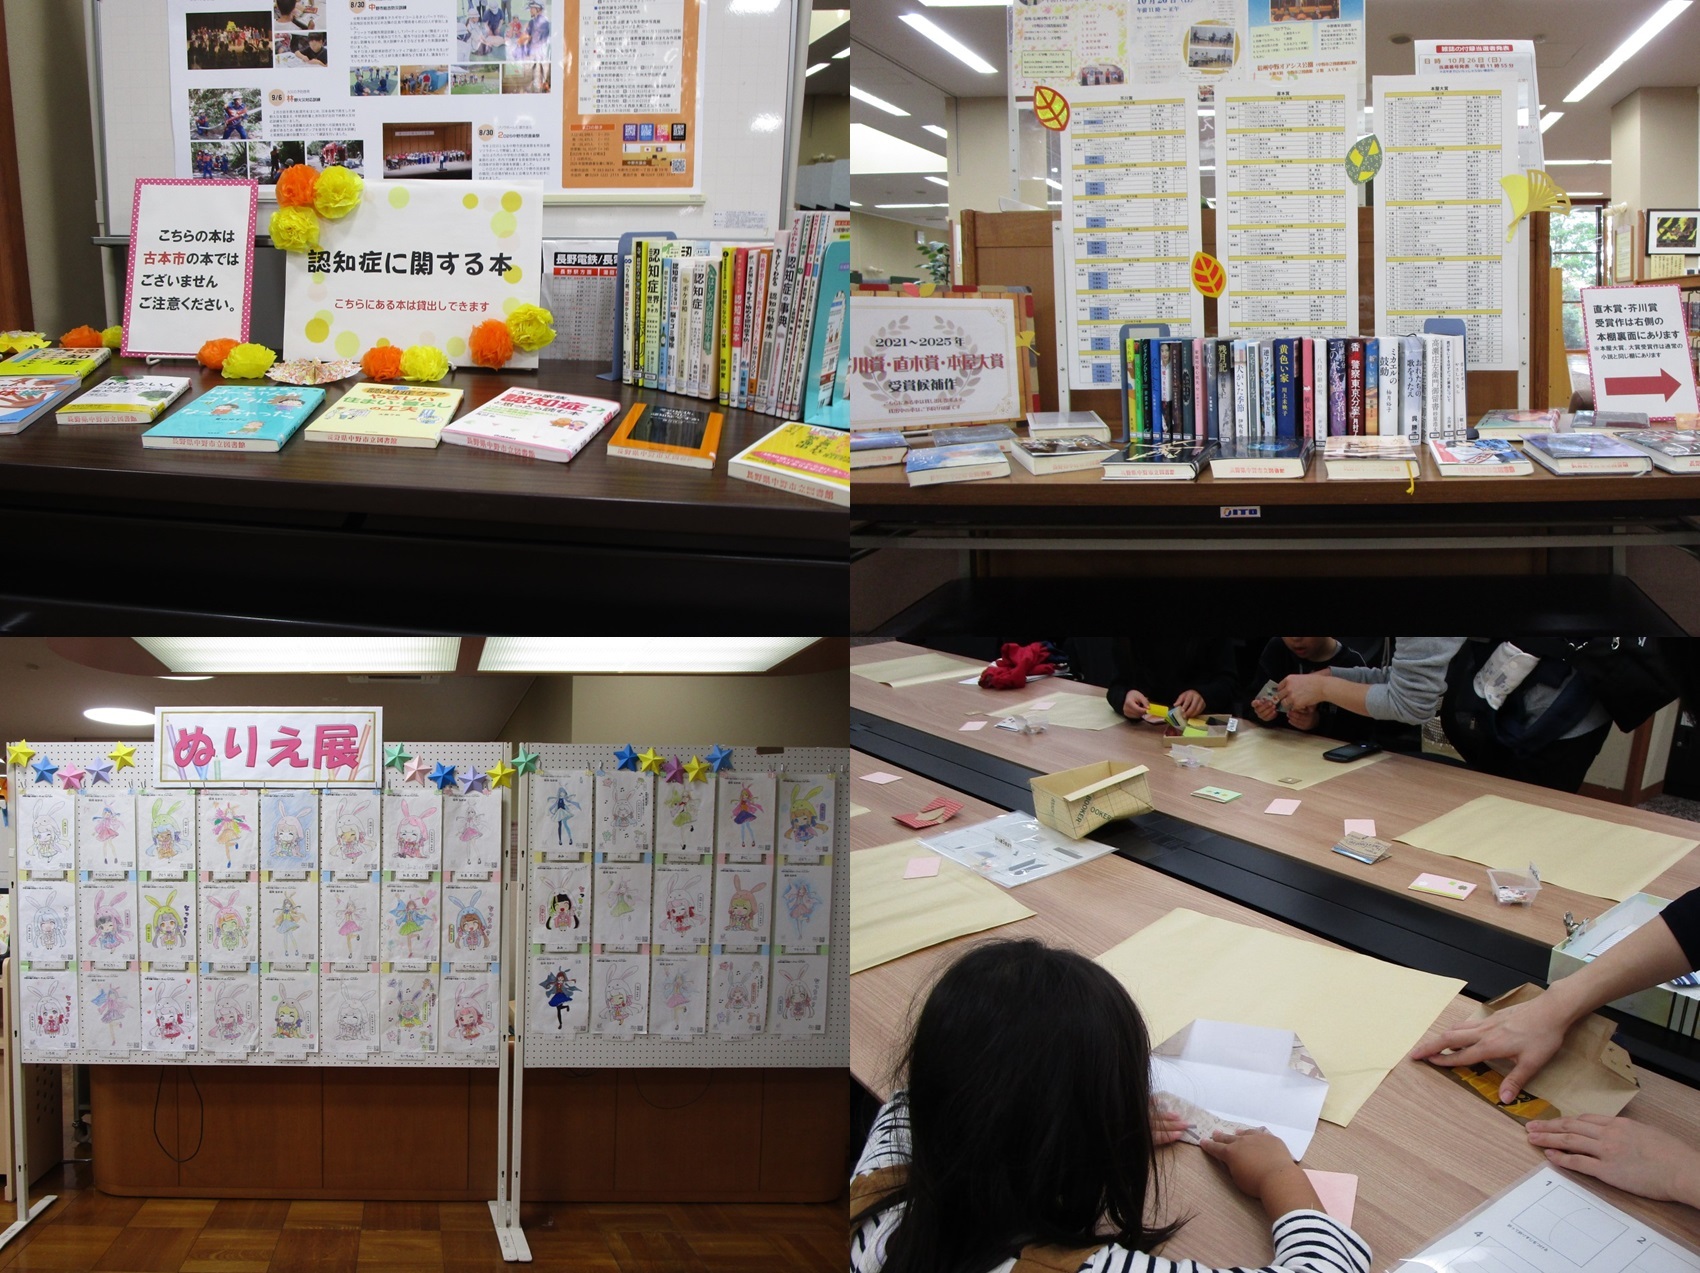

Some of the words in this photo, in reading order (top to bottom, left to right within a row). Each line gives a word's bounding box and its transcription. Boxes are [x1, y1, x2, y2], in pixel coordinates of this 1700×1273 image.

[159, 229, 235, 243] こちらの本は
[789, 217, 800, 254] ぜんぶわかる
[143, 251, 239, 266] 古本市の本では
[307, 249, 513, 277] 認知症に関する本
[141, 274, 218, 288] ございません
[778, 255, 797, 330] 認知症の事典
[139, 296, 235, 312] ご注意ください。
[334, 298, 490, 313] こちらにある本は貸出しできます
[1593, 303, 1658, 314] 直木賞・芥川賞
[763, 292, 778, 340] 認知行動療法
[1594, 317, 1664, 328] 受賞作は右側の
[1596, 330, 1680, 342] 本棚裏面にあります
[850, 353, 1004, 375] 川賞・直木賞・本屋大賞
[1217, 344, 1228, 373] 残月記
[1278, 343, 1290, 384] 黄色い家
[1601, 352, 1662, 360] 小説と同じ棚にあります
[1263, 349, 1271, 385] 逆ソクラテス
[1379, 356, 1390, 377] 鼓動
[1389, 347, 1398, 385] ミカエルの
[1431, 338, 1440, 412] 高瀬庄左衛門御留書
[888, 378, 958, 393] 受賞候補作
[1407, 359, 1415, 398] 歌をうたえ
[1236, 364, 1245, 413] 犬がいた季節
[343, 396, 452, 409] 住まい・暮らし
[370, 393, 435, 403] やさしい
[173, 723, 362, 770] ぬりえ展
[1474, 1230, 1483, 1238] 4
[1636, 1235, 1647, 1245] 2
